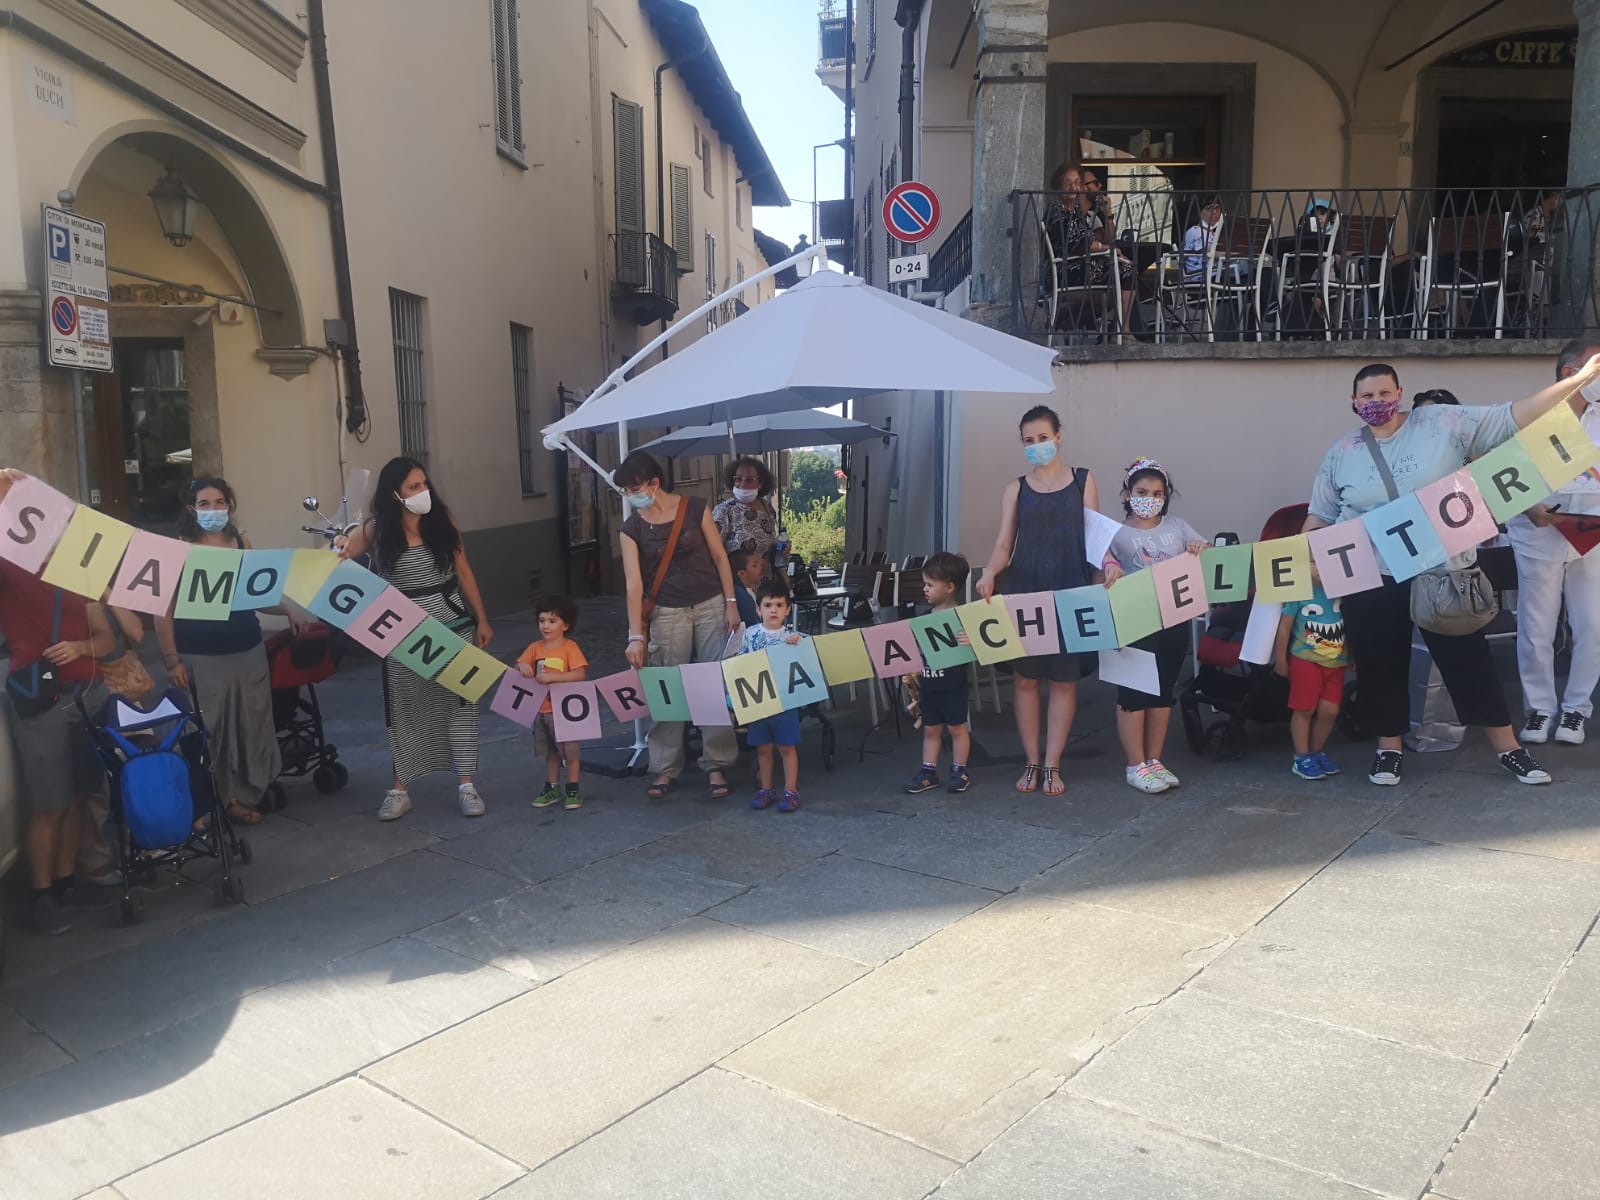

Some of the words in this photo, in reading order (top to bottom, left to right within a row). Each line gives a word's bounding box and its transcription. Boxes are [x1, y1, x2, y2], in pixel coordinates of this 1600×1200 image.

[35, 84, 64, 109] DUCH
[71, 219, 103, 236] MONCALIERI
[52, 226, 67, 257] P
[895, 262, 921, 274] 0-24
[6, 506, 278, 604] SIAMO
[328, 583, 672, 721] GENITORI
[734, 661, 816, 708] MA
[883, 606, 1100, 665] ANCHE
[1170, 434, 1572, 609] ELETTORI
